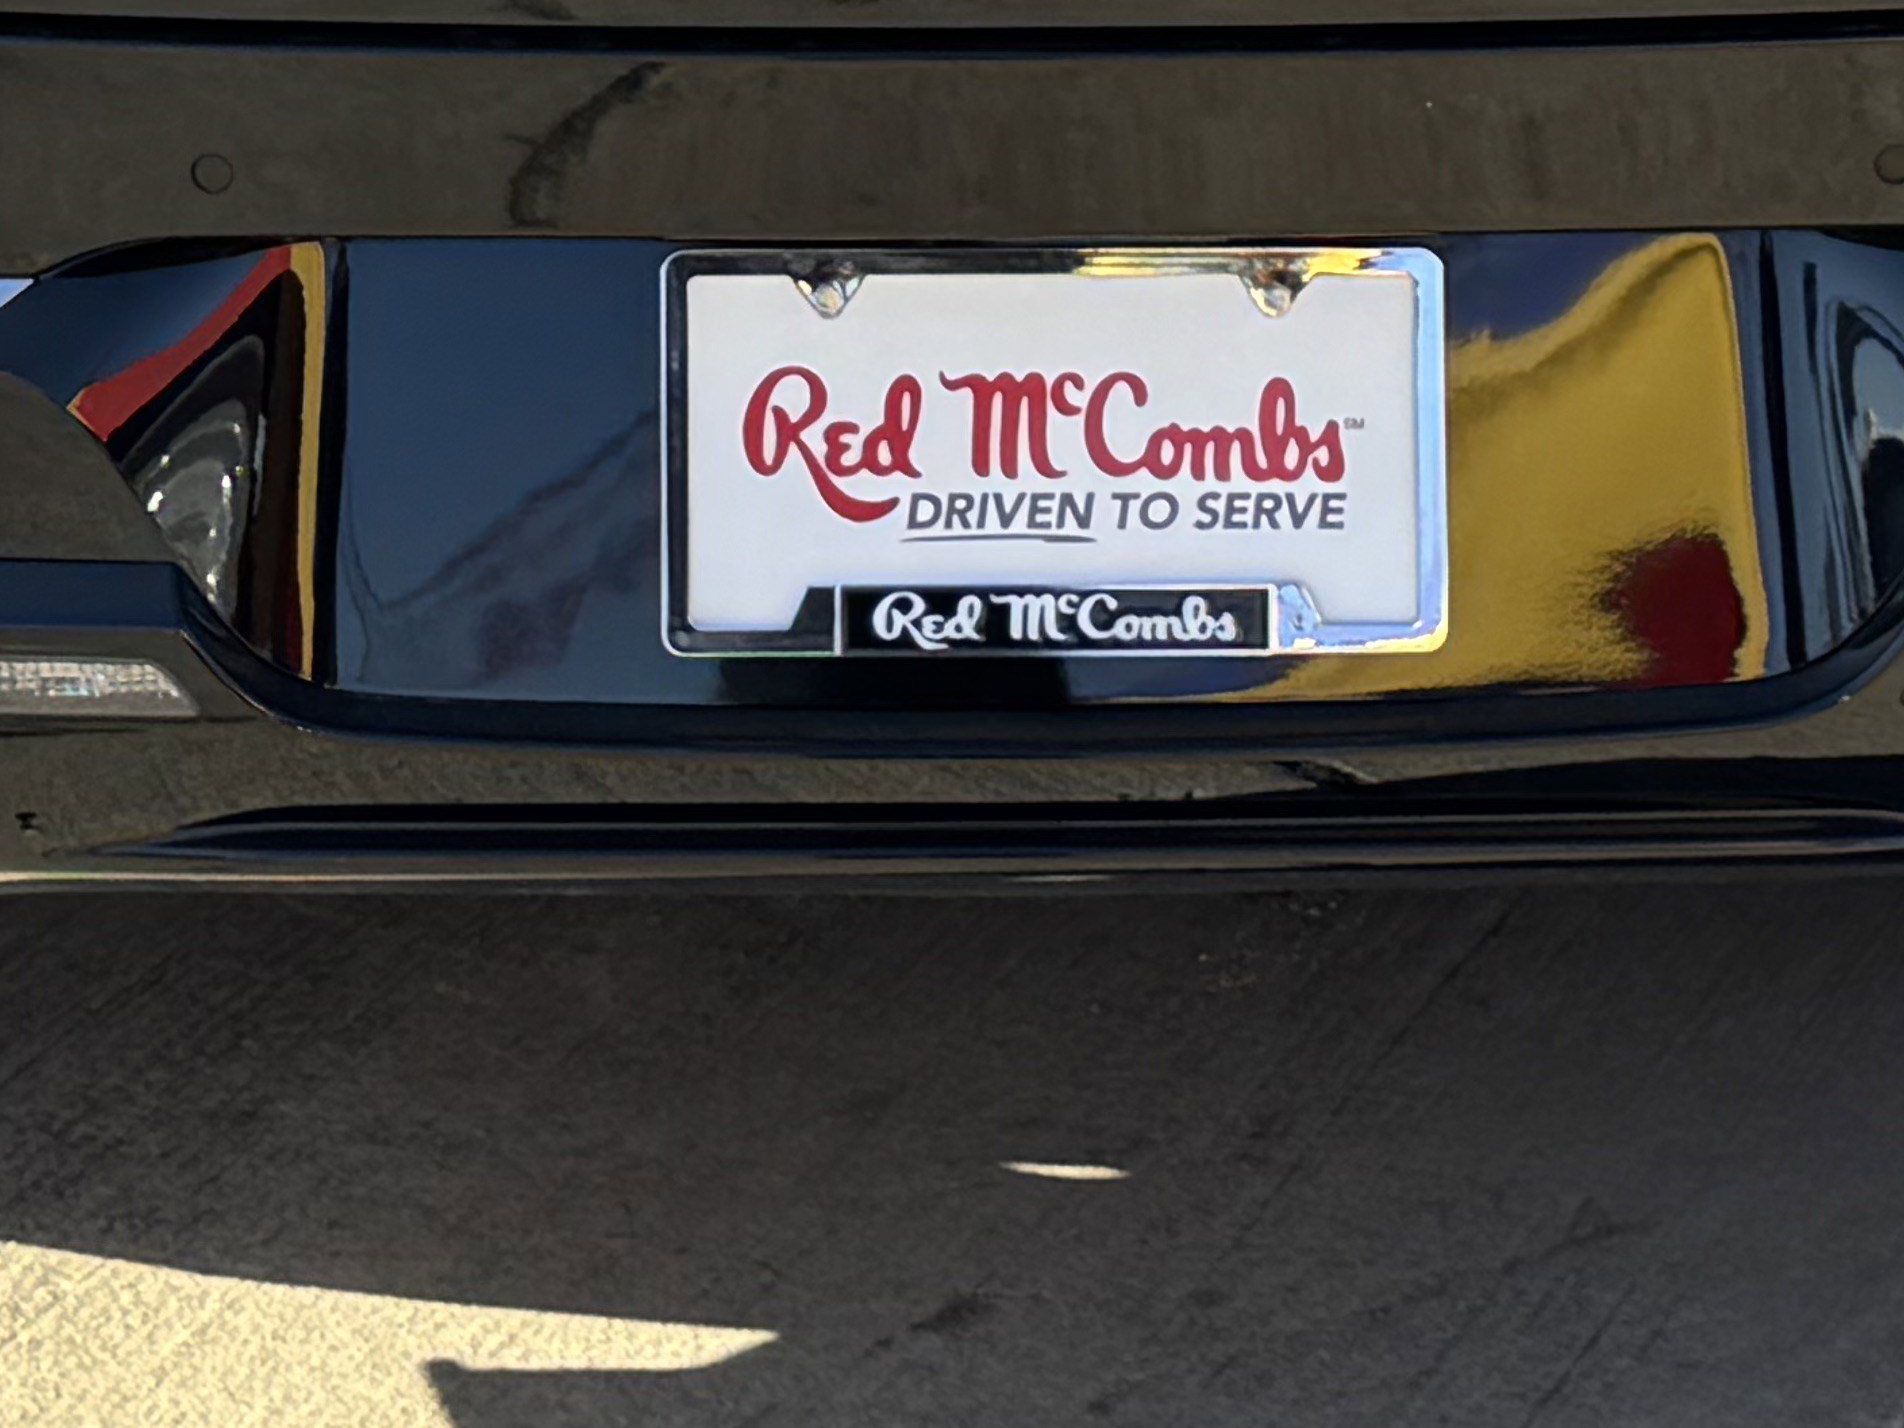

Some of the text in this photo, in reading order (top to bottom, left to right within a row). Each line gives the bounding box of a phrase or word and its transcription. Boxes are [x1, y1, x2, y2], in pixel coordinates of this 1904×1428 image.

[743, 365, 924, 523] Red
[939, 370, 1347, 483] McCombs
[907, 491, 1348, 531] DRIVEN TO SERVE
[873, 591, 1237, 650] Red McCombs
